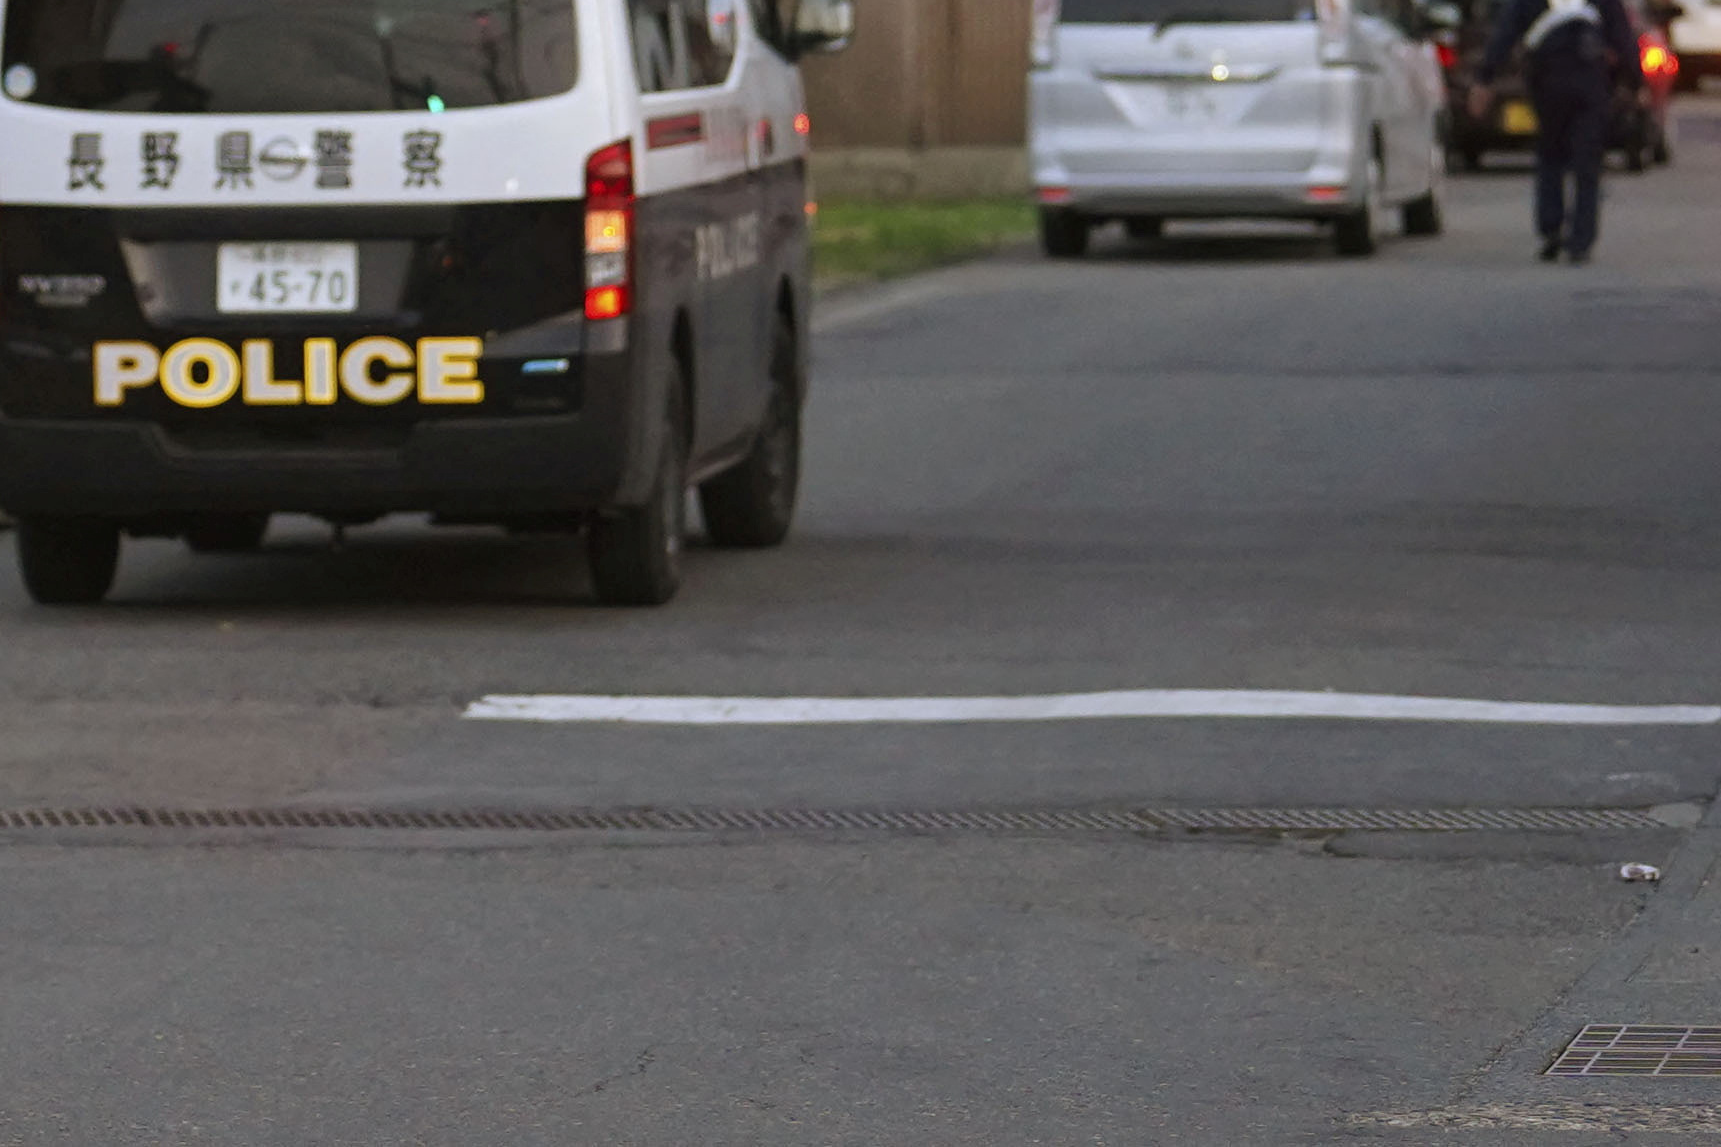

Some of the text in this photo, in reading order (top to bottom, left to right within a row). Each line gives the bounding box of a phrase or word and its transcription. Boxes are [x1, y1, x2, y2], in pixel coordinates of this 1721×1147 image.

[67, 130, 442, 191] 長野県警察
[249, 270, 346, 303] 45-70
[93, 336, 484, 408] POLICE
